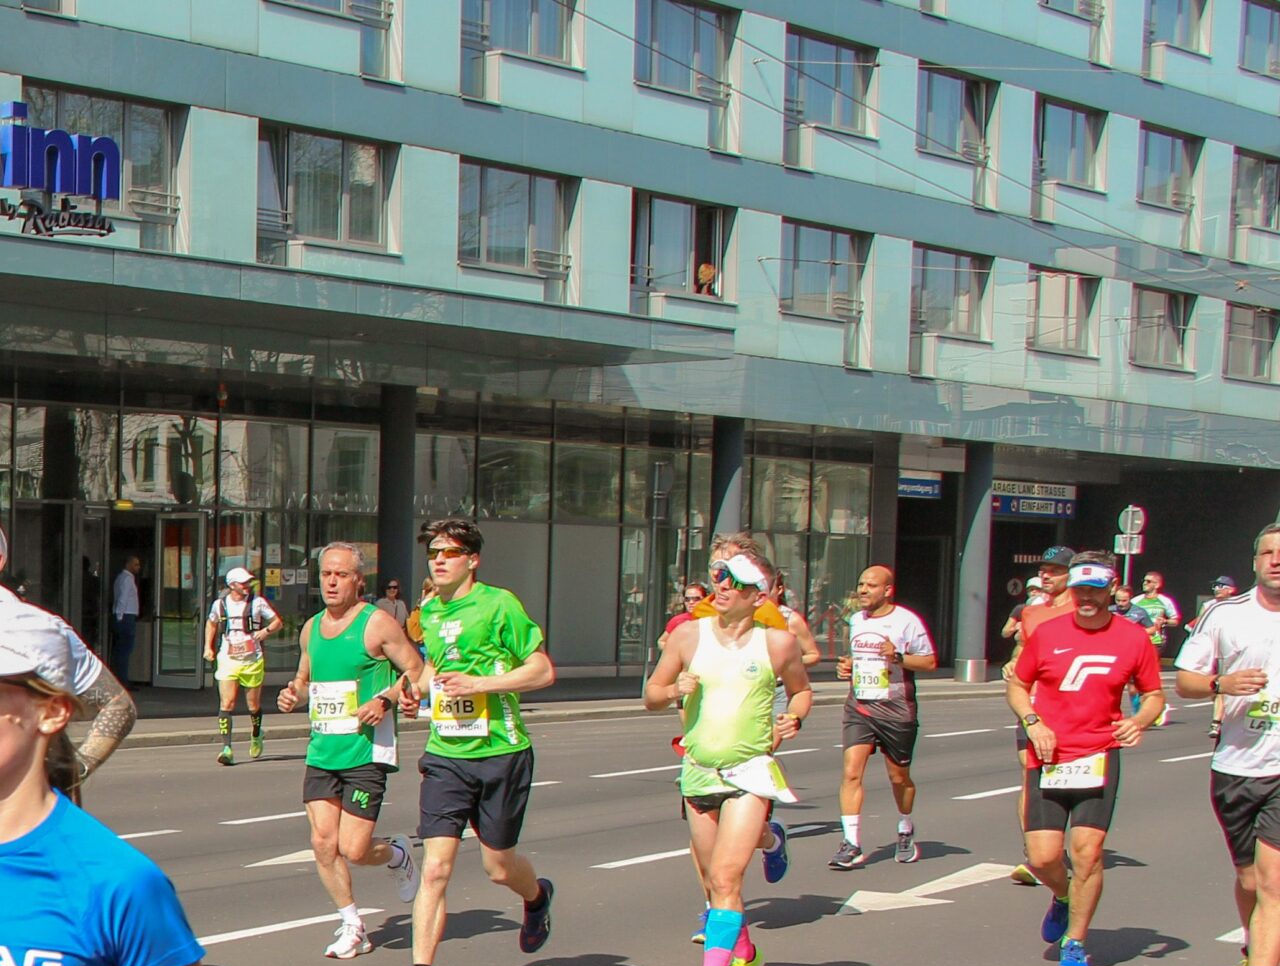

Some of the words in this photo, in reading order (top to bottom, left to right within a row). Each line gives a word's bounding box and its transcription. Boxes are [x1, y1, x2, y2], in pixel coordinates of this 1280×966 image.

[0, 101, 120, 201] inn
[1021, 501, 1053, 513] EINFAHRT
[853, 639, 882, 650] Taked
[856, 675, 880, 686] 3130
[316, 702, 345, 715] 5797
[438, 699, 475, 714] 651B
[1055, 766, 1091, 775] 5372
